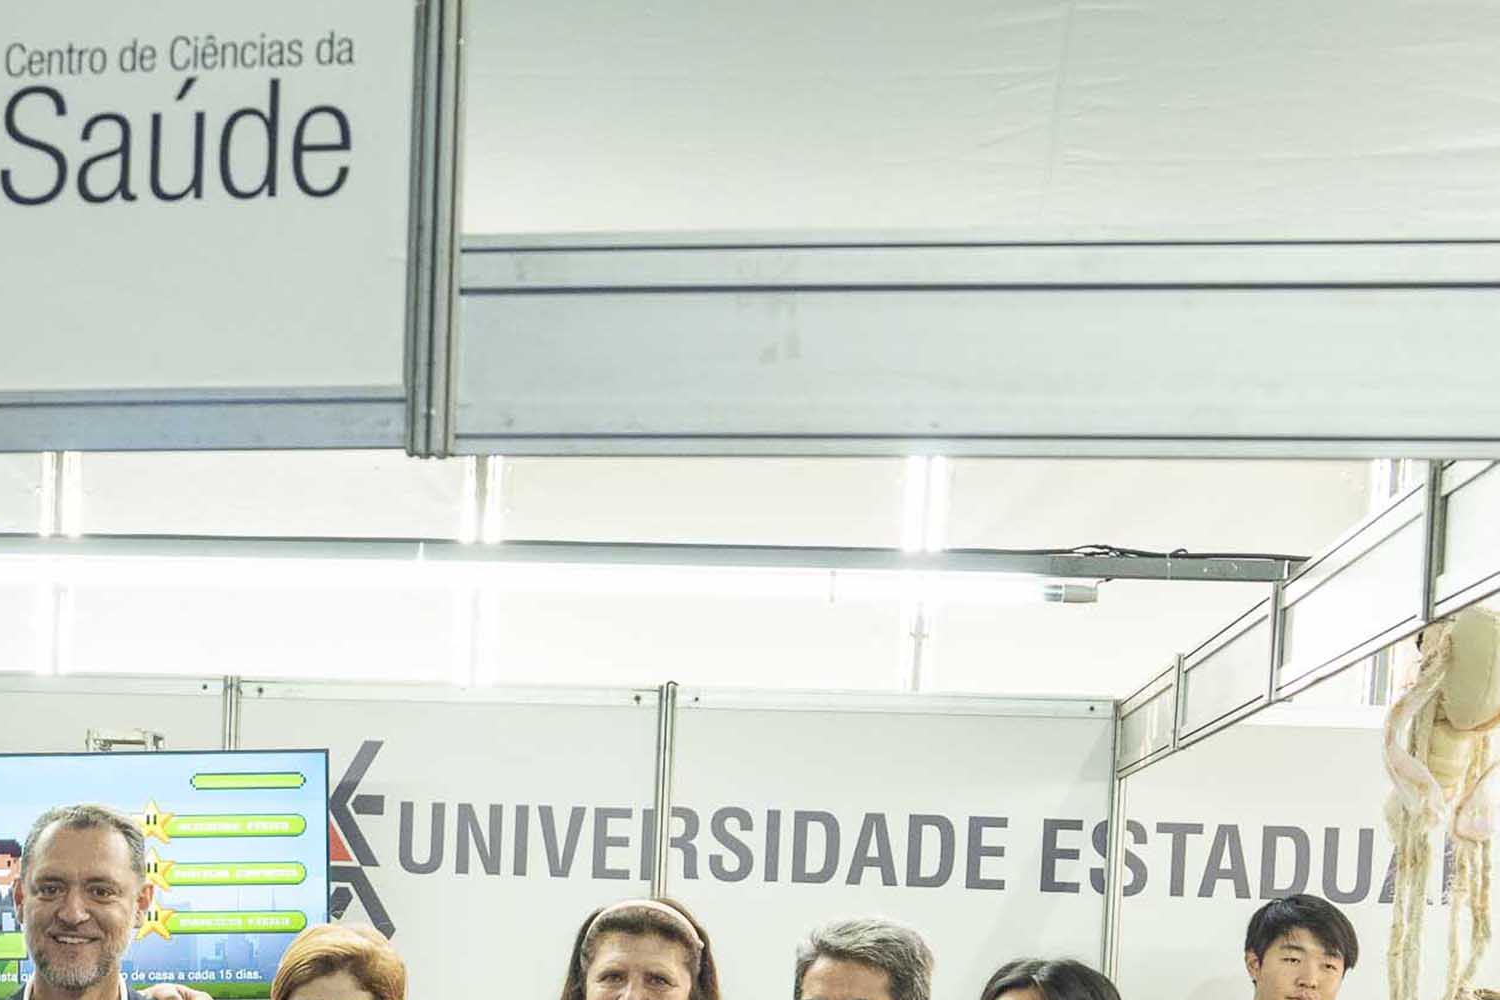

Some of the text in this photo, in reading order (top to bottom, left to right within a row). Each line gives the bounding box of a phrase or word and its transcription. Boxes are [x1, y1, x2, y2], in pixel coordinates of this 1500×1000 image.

[4, 31, 355, 78] Centro de Ciências da
[0, 76, 352, 206] Saúde
[399, 801, 1009, 890] UNIVERSIDADE
[131, 968, 146, 981] de
[148, 971, 175, 981] casa
[188, 968, 217, 981] cada
[220, 968, 233, 980] 15
[236, 967, 263, 980] dias.
